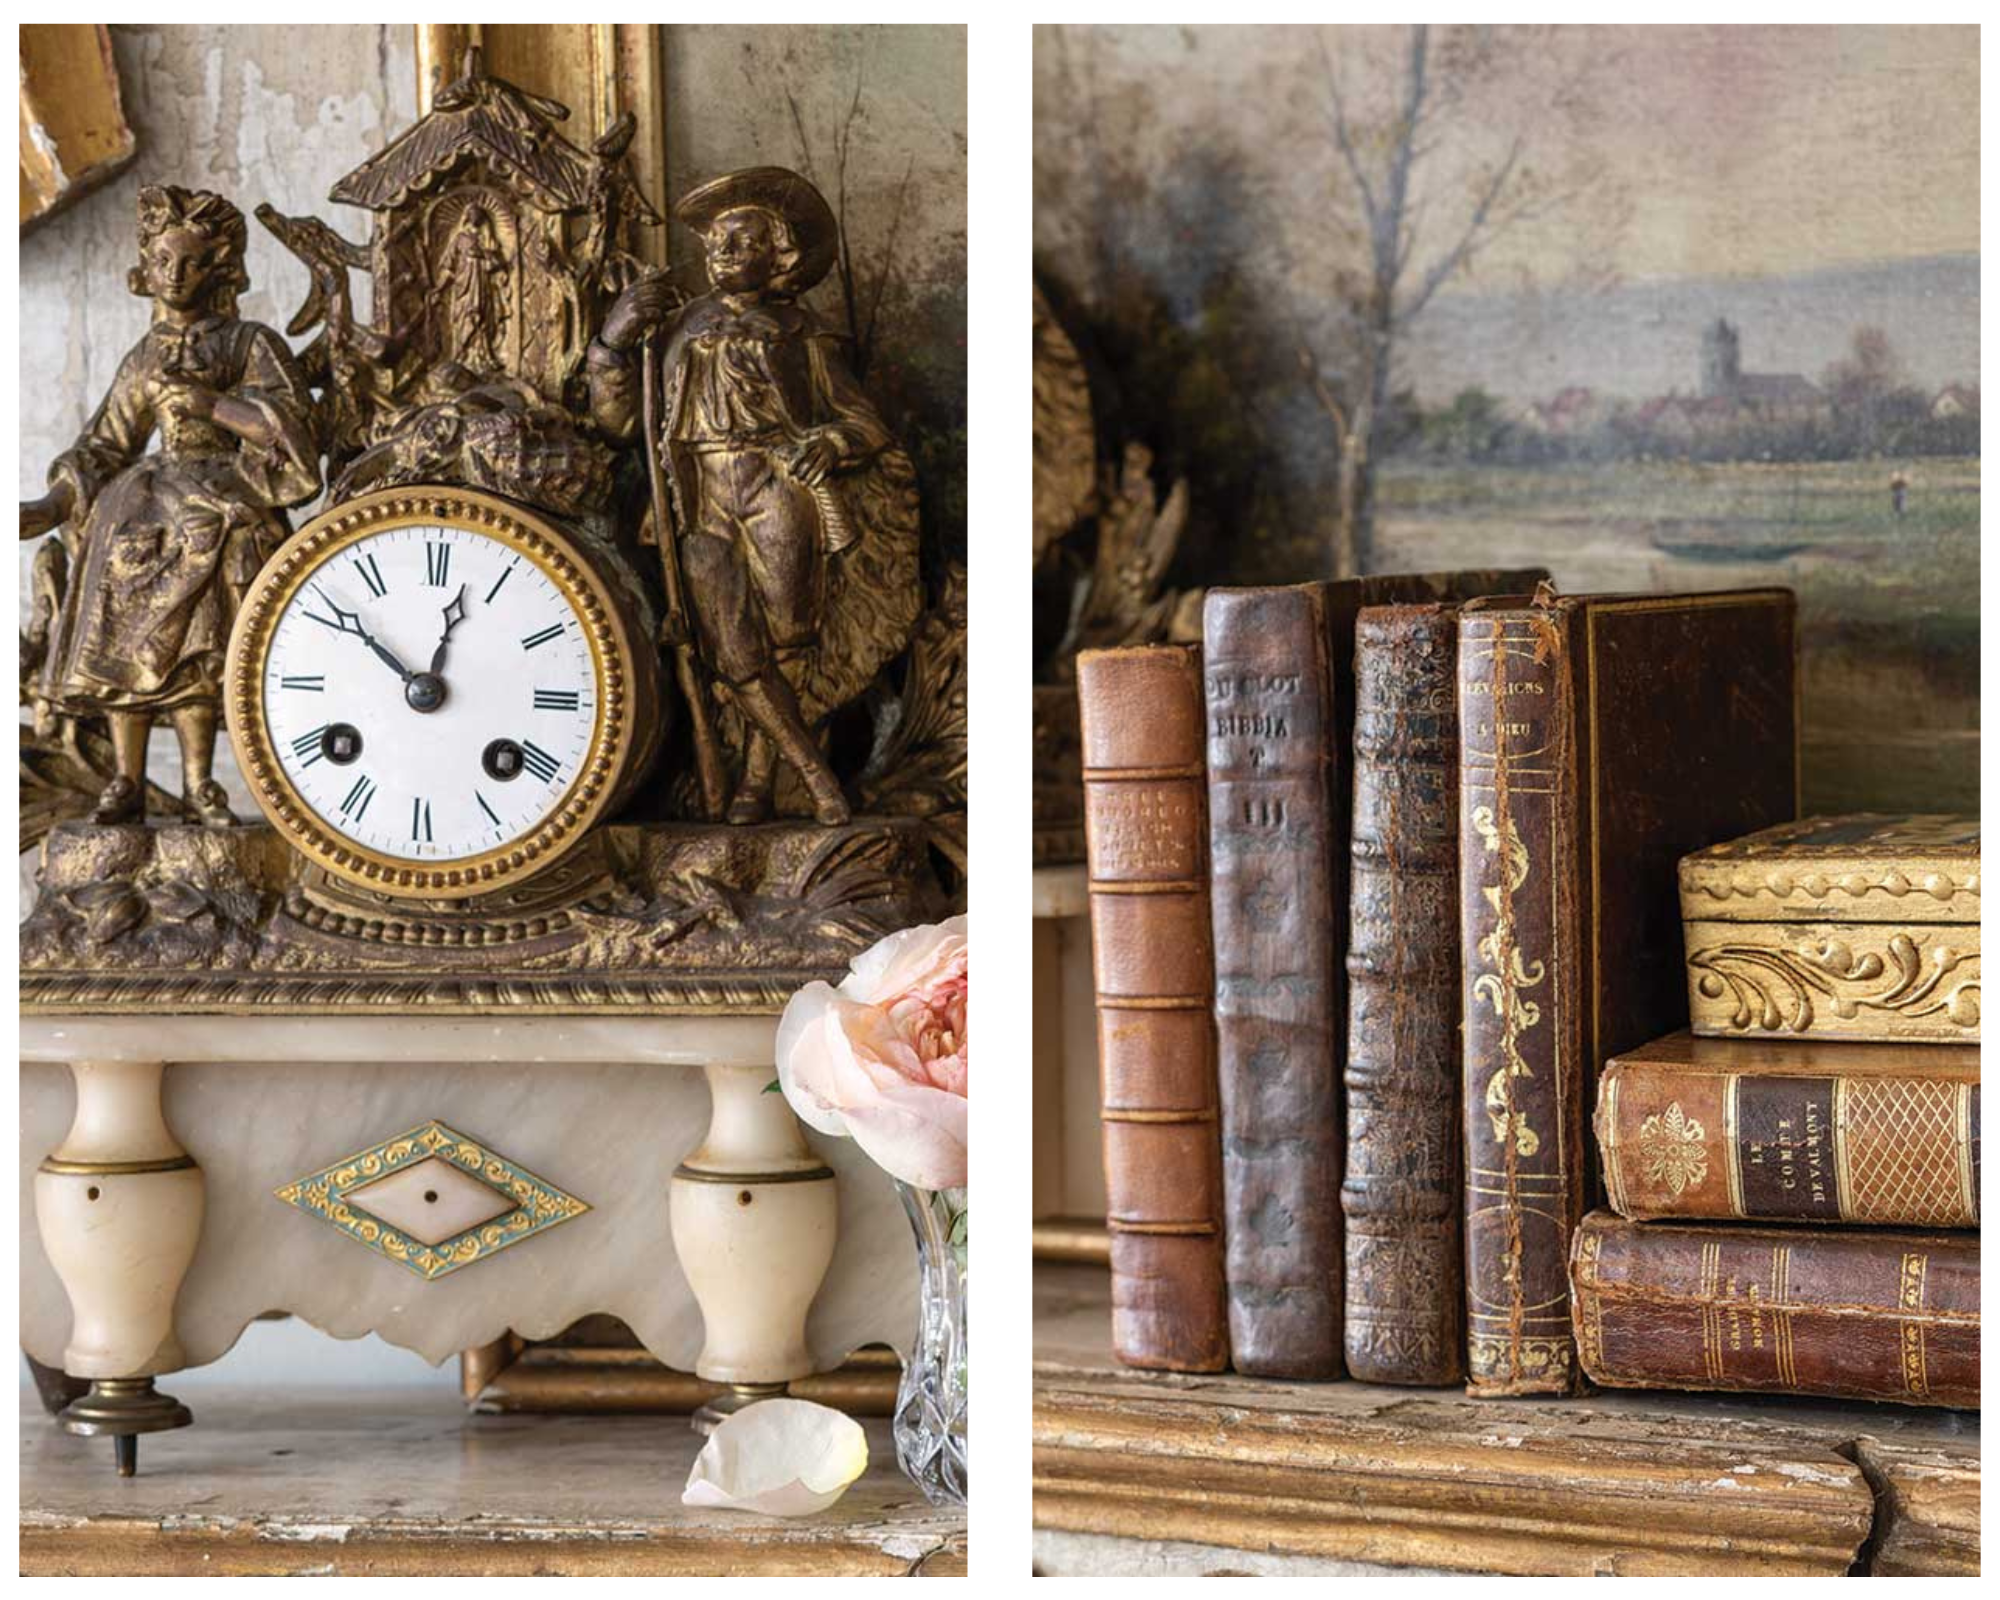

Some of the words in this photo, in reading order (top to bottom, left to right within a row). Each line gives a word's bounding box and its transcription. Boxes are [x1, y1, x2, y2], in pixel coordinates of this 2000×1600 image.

[353, 553, 388, 600] XI
[422, 541, 451, 587] XII
[522, 622, 565, 650] II
[533, 689, 579, 711] III
[1217, 713, 1287, 740] BIBBIA
[1750, 1141, 1763, 1165] LE
